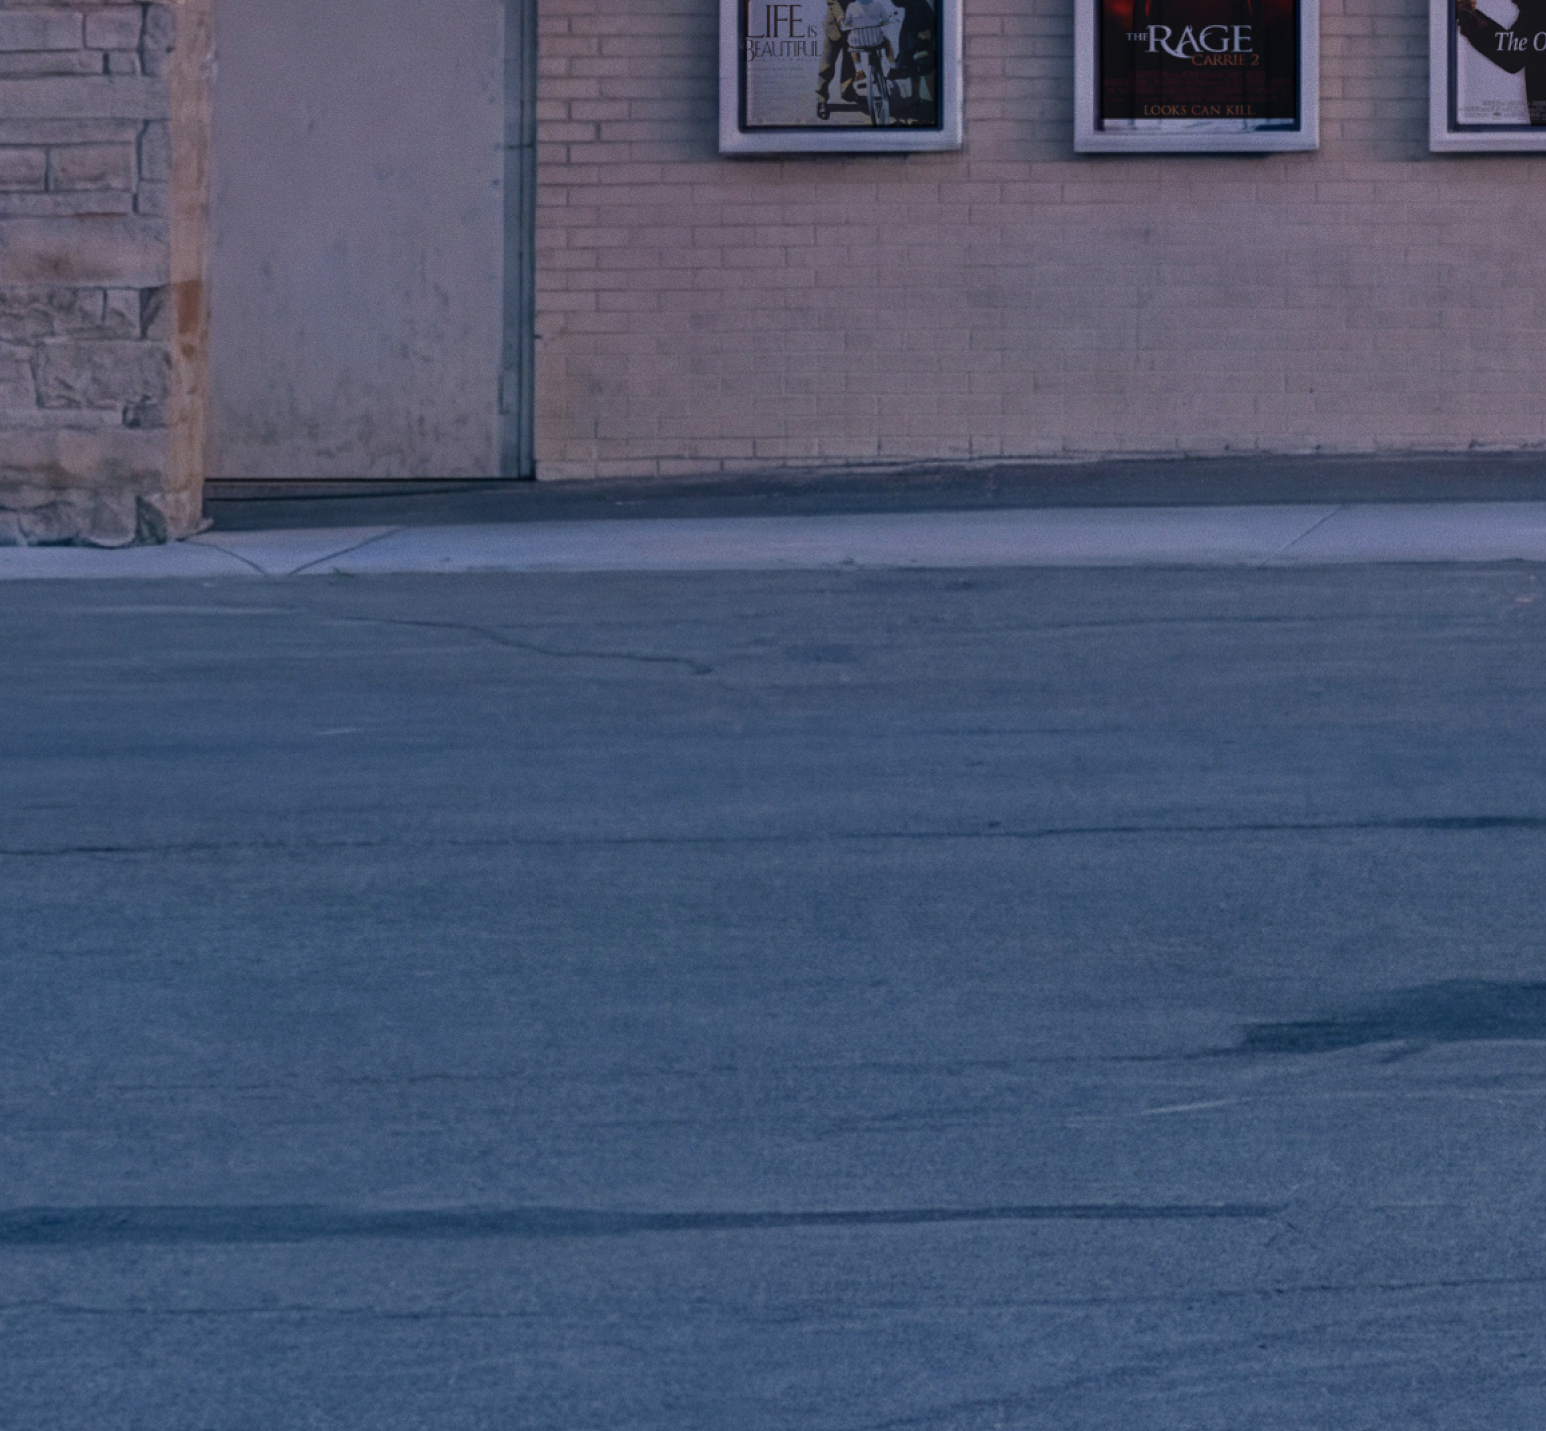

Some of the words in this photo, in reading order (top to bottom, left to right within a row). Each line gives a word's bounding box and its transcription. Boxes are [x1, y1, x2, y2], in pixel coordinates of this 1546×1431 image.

[745, 0, 806, 39] LIFE
[806, 25, 818, 38] IS
[746, 39, 823, 62] BEAUTIFUL
[1126, 32, 1149, 42] THE
[1144, 25, 1253, 59] RAGE
[1494, 31, 1528, 52] The
[1191, 53, 1247, 66] CARRIE
[1250, 53, 1260, 66] 2
[1144, 104, 1188, 117] LOOKS
[1190, 104, 1222, 117] CAN
